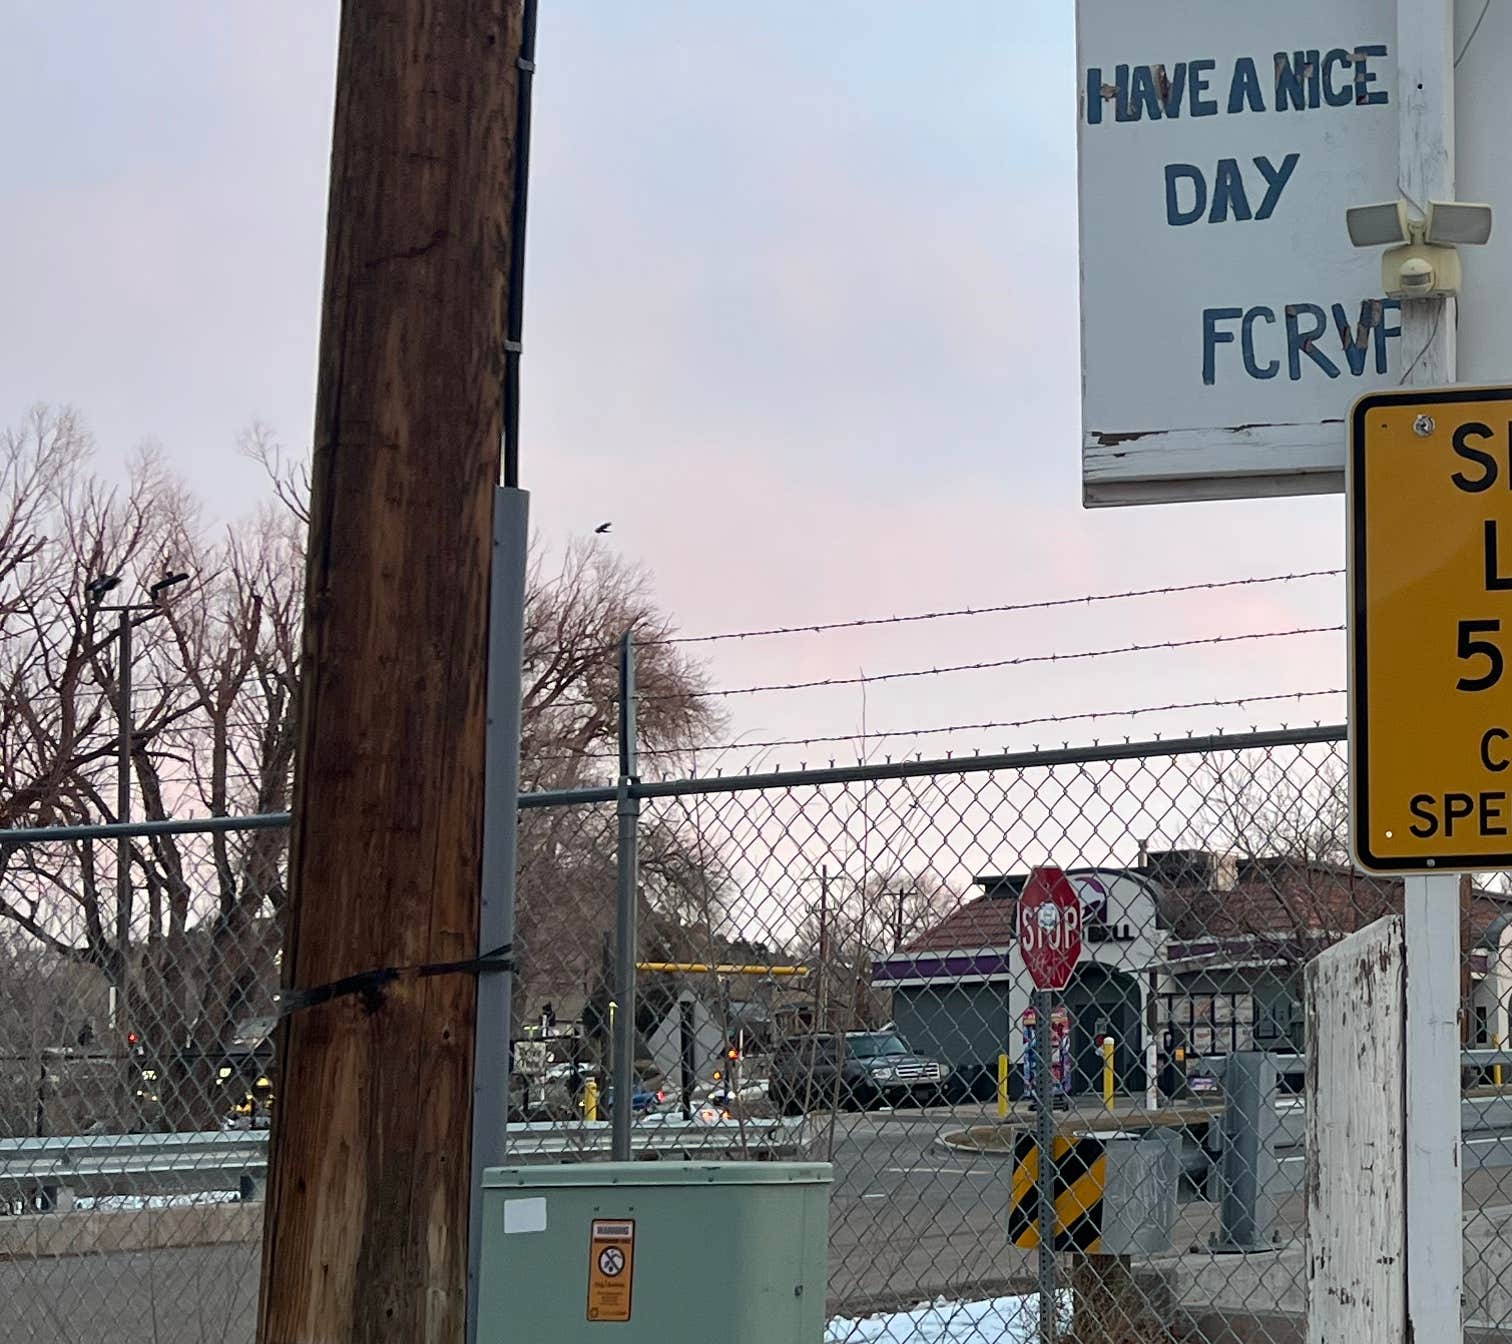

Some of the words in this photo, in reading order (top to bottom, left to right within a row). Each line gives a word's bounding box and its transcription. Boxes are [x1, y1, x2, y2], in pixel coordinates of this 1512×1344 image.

[1087, 59, 1217, 124] HAVE
[1227, 57, 1266, 113] A
[1273, 45, 1389, 112] NICE
[1164, 153, 1300, 226] DAY
[1455, 619, 1504, 692] 5
